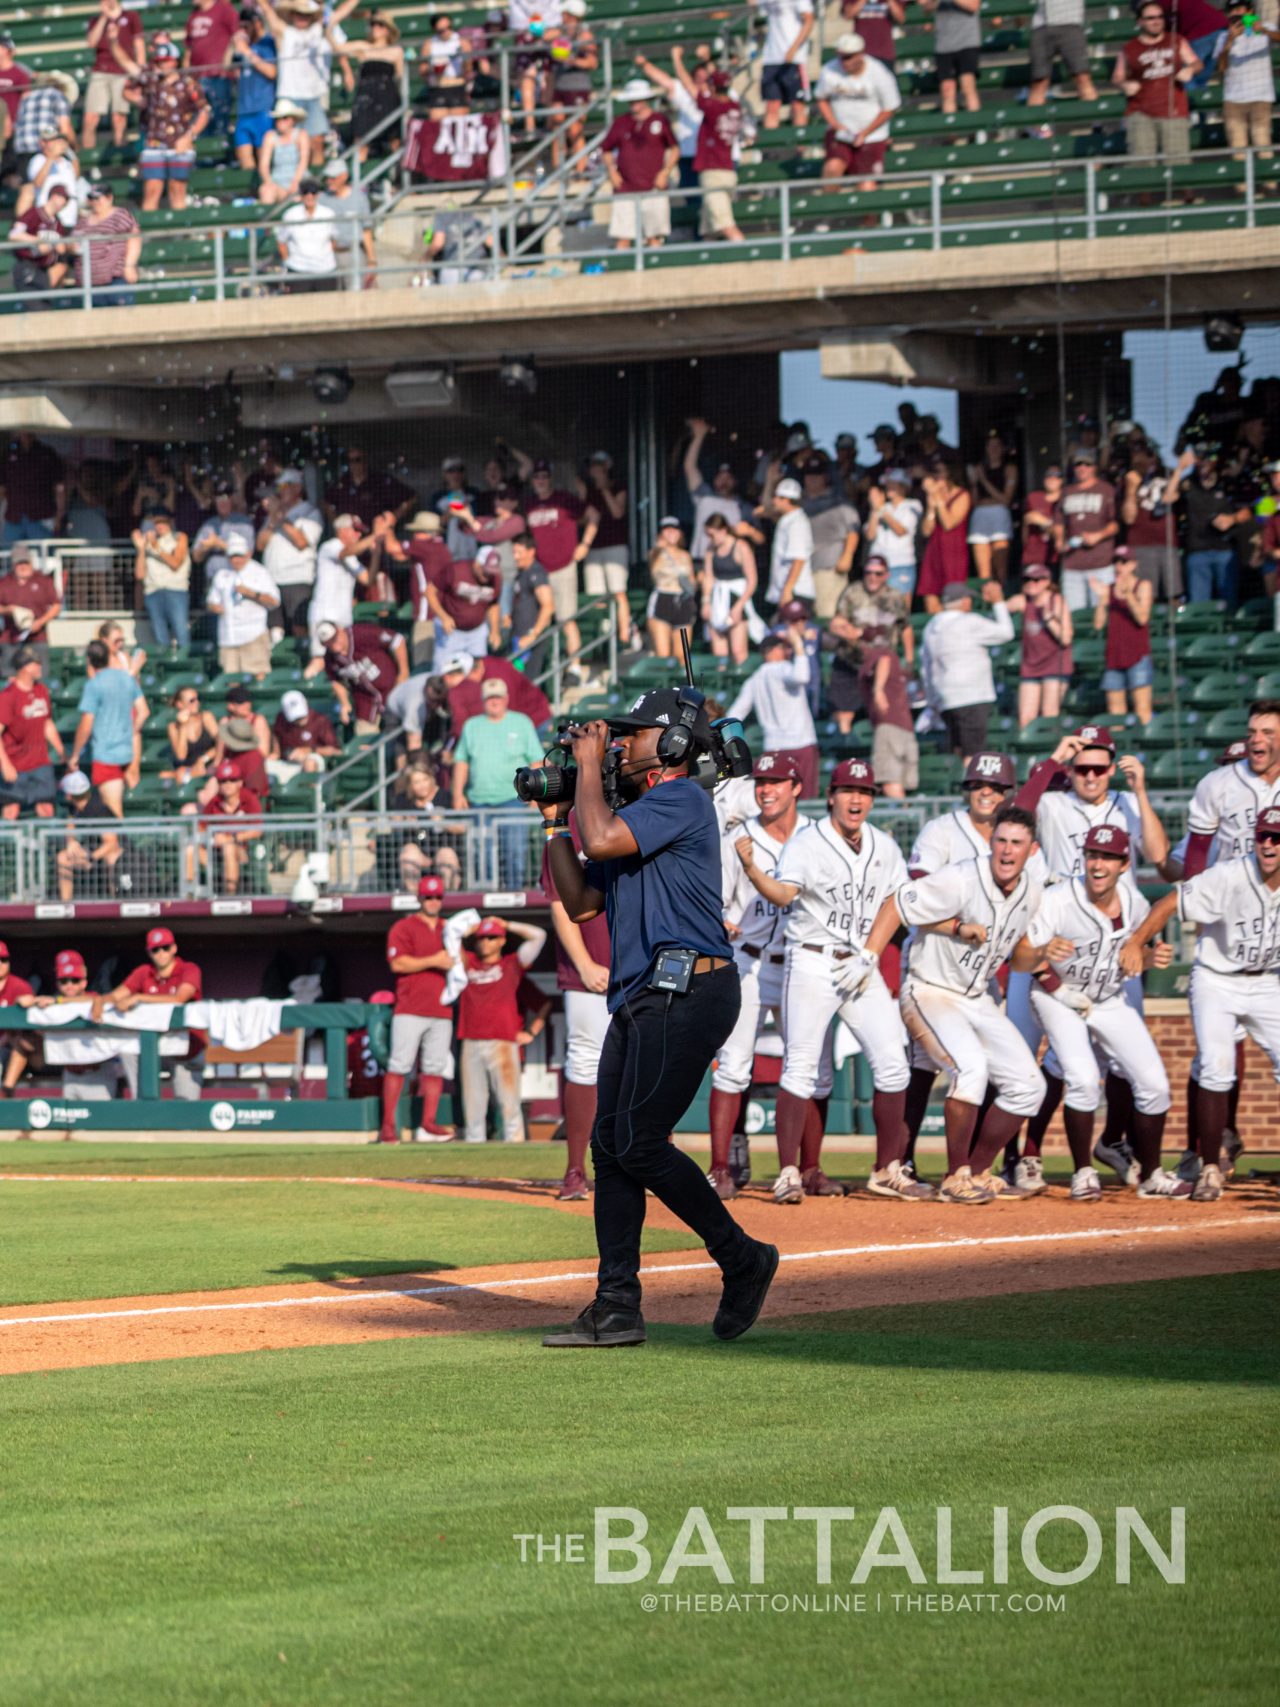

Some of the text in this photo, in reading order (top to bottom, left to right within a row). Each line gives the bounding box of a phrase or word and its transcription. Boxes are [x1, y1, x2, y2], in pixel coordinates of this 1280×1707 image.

[826, 882, 876, 903] TEXA
[52, 1107, 89, 1118] FARMS
[237, 1109, 275, 1120] FARMS
